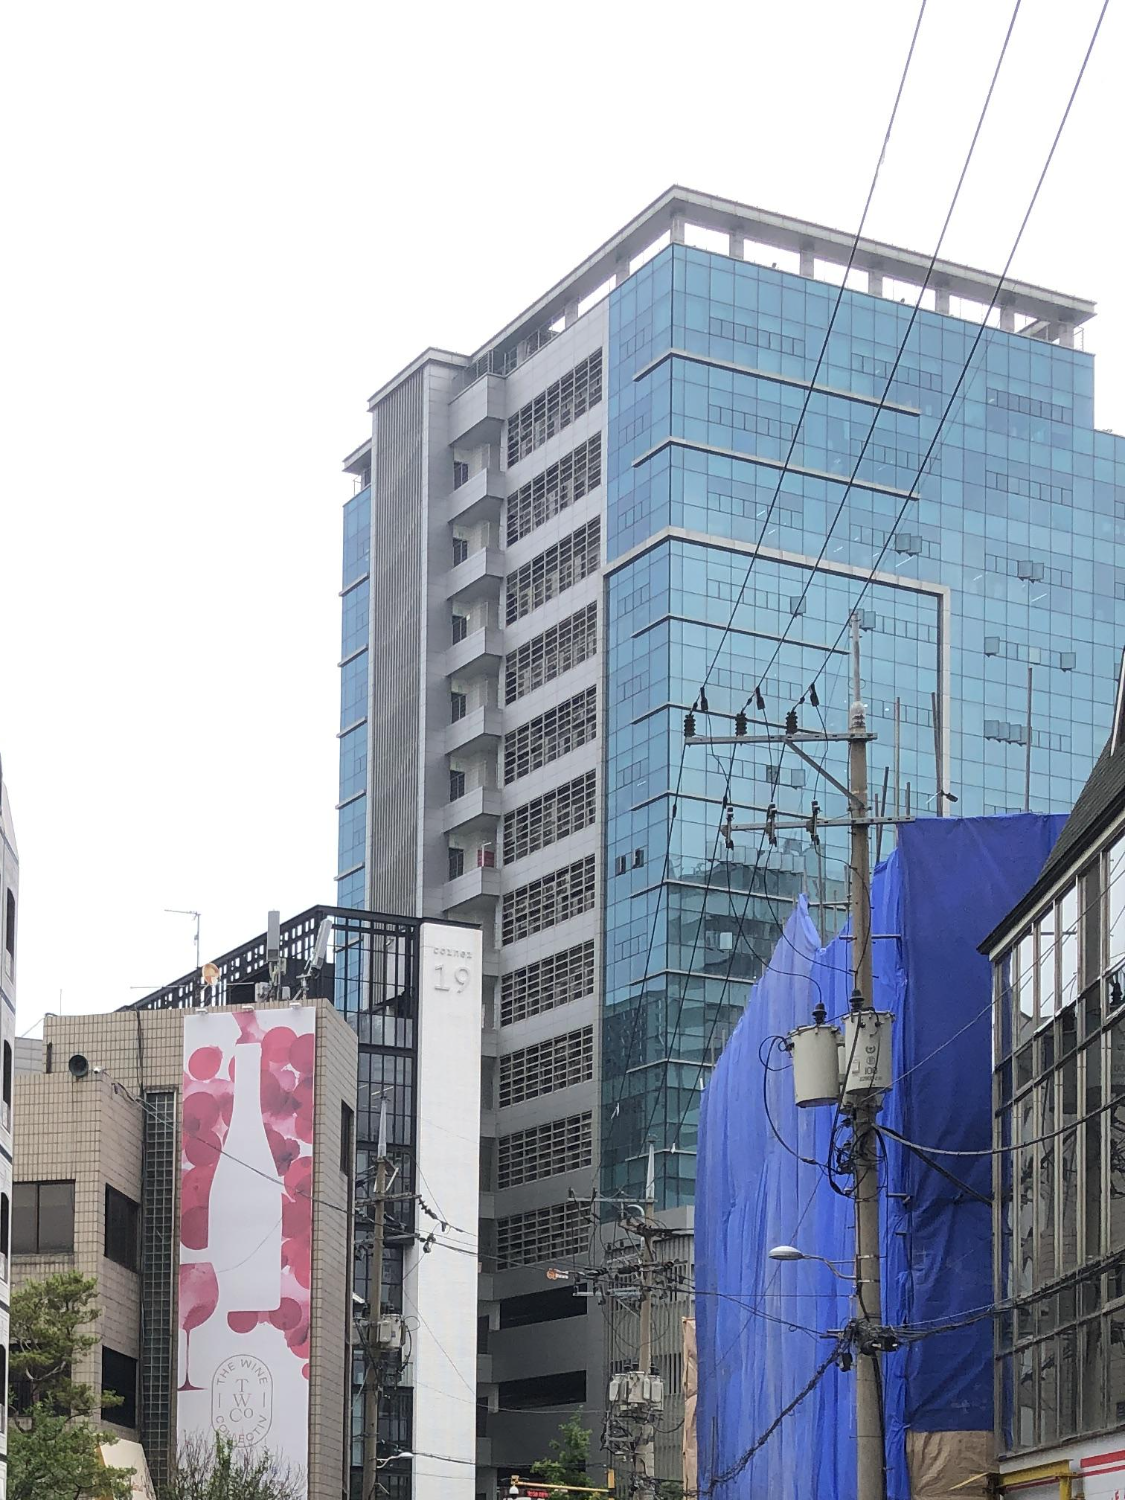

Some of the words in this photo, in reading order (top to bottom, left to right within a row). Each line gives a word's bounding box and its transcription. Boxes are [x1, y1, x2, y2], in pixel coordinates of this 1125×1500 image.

[434, 963, 472, 994] 19
[216, 1362, 236, 1386] THE
[240, 1358, 269, 1385] WINE
[235, 1378, 250, 1393] T
[232, 1393, 253, 1408] W
